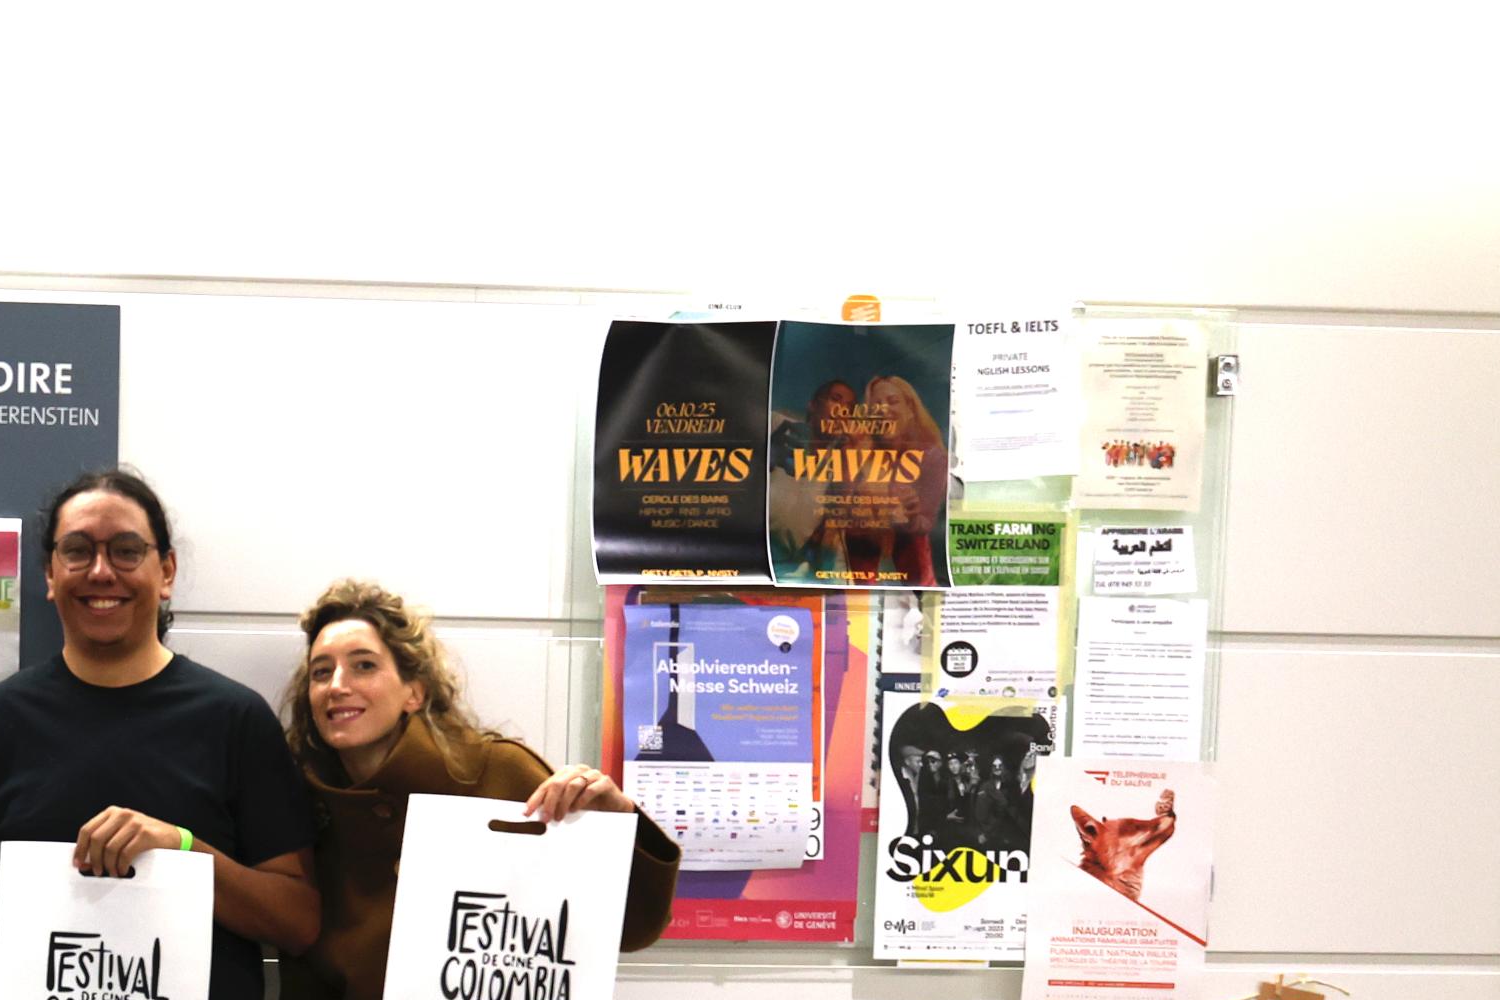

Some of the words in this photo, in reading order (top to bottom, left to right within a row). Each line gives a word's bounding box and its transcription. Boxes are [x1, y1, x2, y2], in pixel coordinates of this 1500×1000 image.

[967, 322, 1007, 335] TOEFL
[1010, 321, 1021, 334] &
[1025, 319, 1059, 333] IELTS
[1011, 365, 1050, 374] LESSONS
[645, 418, 726, 434] VENDREDI
[820, 419, 898, 435] VENDREDI
[618, 448, 754, 482] WAVES
[793, 448, 925, 483] WAVES
[950, 523, 1056, 536] TRANSFARMING
[956, 538, 1050, 551] SWITZERLAND
[657, 659, 798, 675] Absolvierenden-
[669, 678, 725, 694] Messe
[728, 678, 799, 694] Schweiz
[885, 834, 1030, 884] Sixun
[1072, 926, 1158, 937] INAUGURATION
[482, 953, 498, 967] DE
